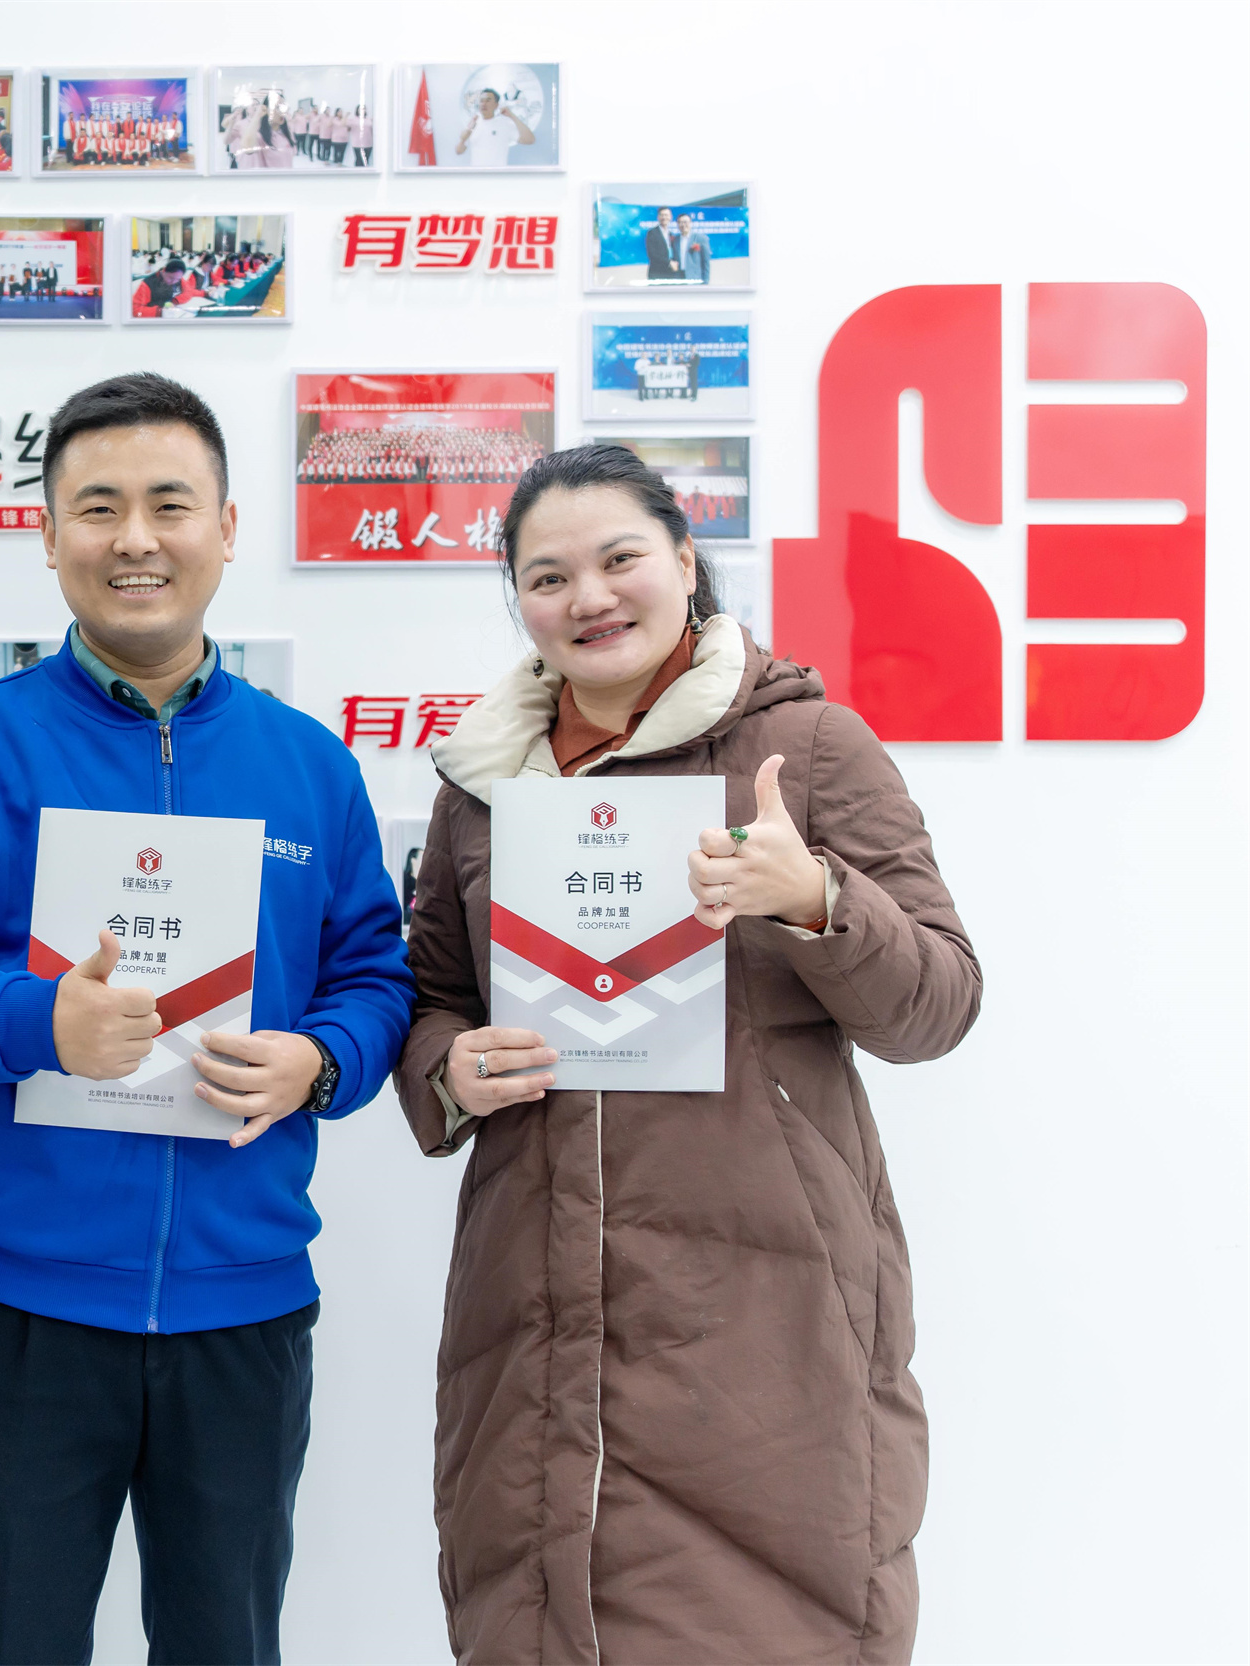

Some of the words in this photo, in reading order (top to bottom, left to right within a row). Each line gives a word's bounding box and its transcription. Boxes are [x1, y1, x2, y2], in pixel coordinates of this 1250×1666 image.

[343, 214, 558, 270] 有梦想
[1, 509, 40, 527] 锋格
[351, 506, 505, 552] 锻人格
[578, 833, 630, 845] 锋格练字
[122, 876, 173, 891] 锋格练字
[565, 871, 643, 895] 合同书
[578, 906, 630, 918] 品牌加盟
[107, 913, 182, 940] 合同书
[577, 921, 631, 930] COOPERATE
[115, 964, 167, 975] COOPERATE
[560, 1049, 648, 1058] 北京锋格书法培训有限公司
[88, 1089, 175, 1103] 北京锋格书法培训有限公司
